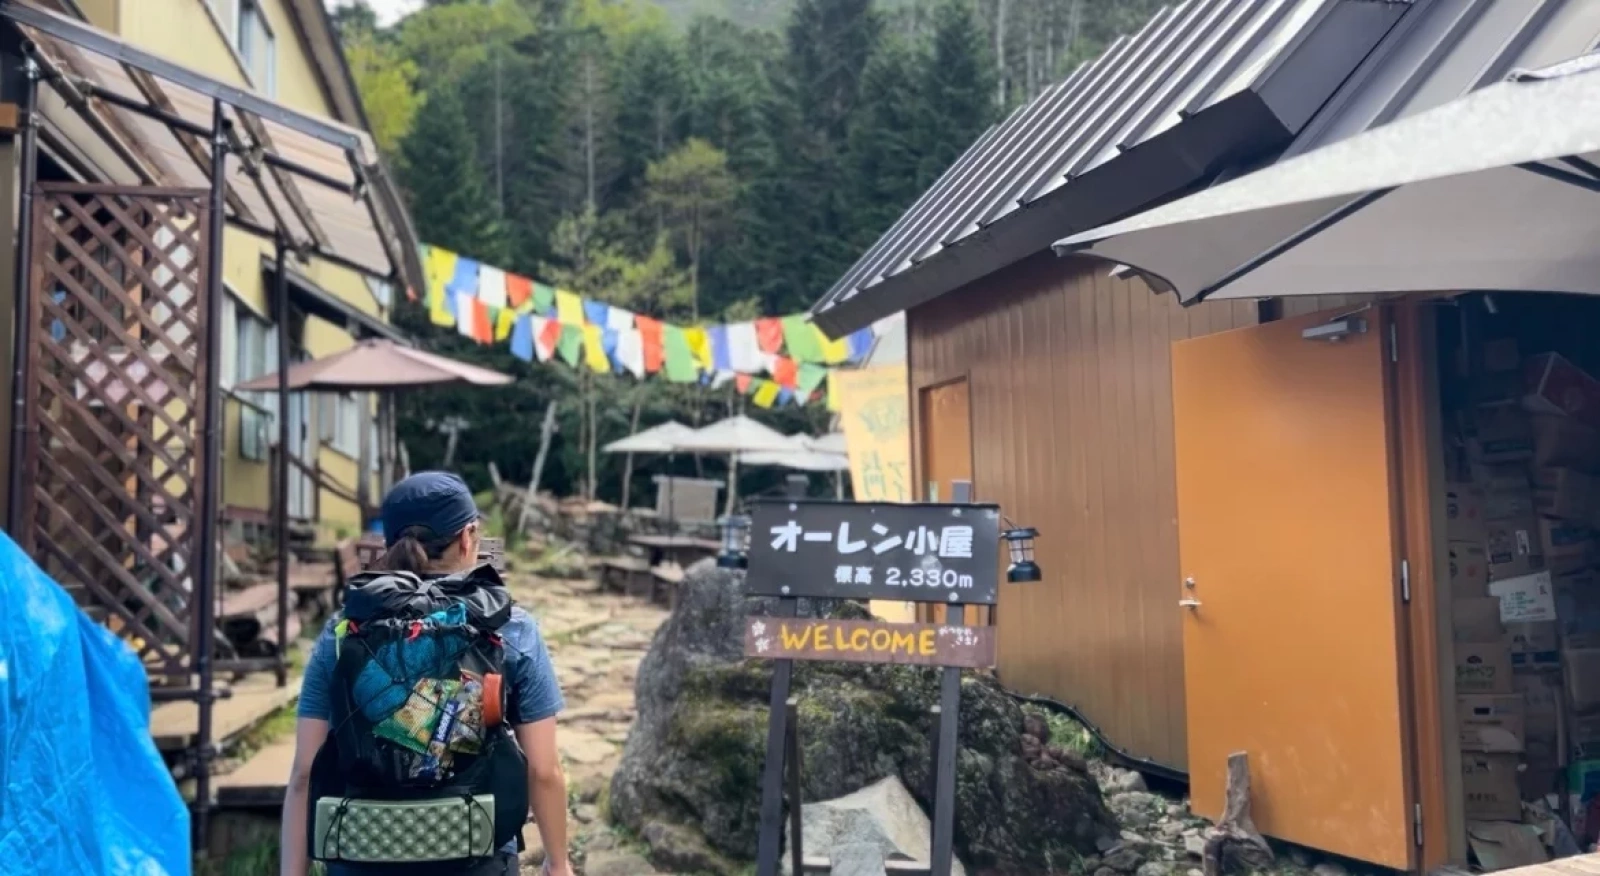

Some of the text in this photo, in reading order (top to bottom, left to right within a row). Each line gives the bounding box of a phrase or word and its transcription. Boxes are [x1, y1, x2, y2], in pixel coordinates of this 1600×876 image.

[770, 520, 973, 558] オーレン小屋
[834, 566, 872, 585] 標高
[781, 624, 937, 656] WELCOME
